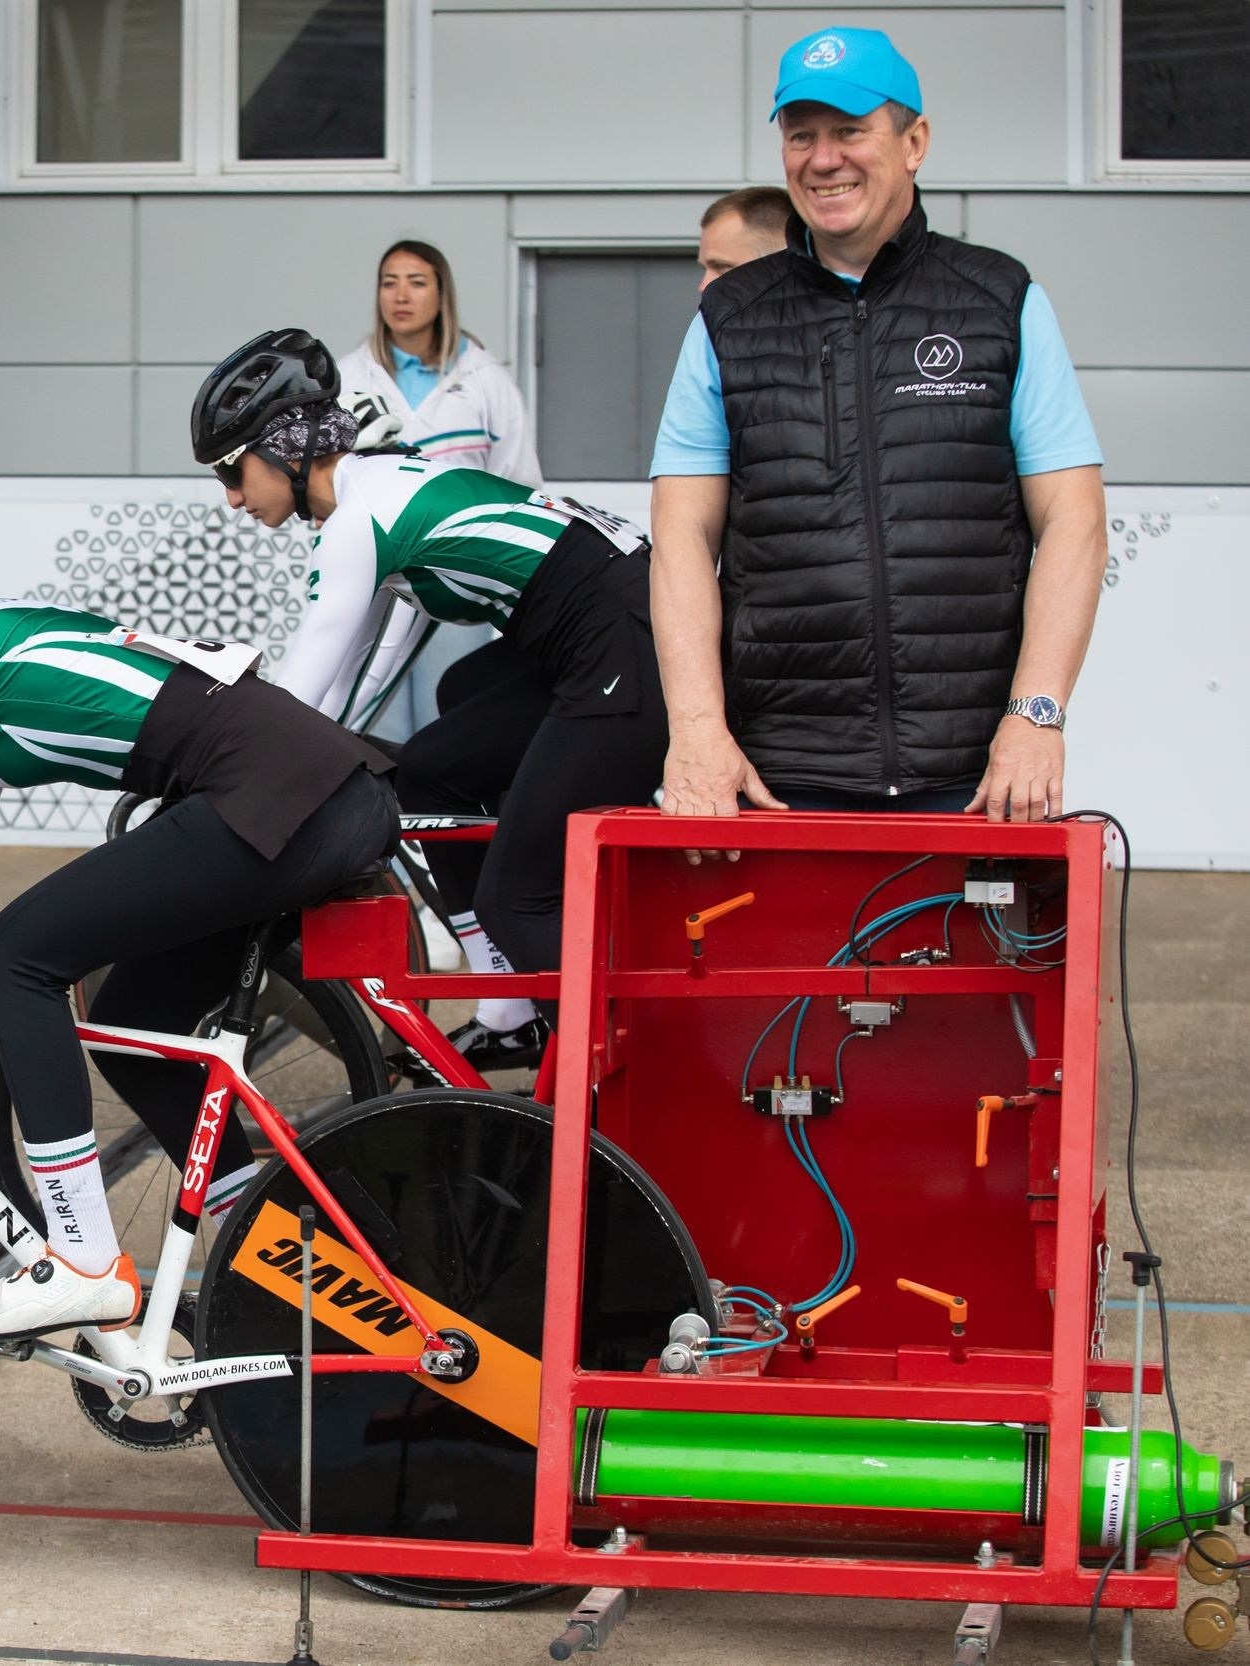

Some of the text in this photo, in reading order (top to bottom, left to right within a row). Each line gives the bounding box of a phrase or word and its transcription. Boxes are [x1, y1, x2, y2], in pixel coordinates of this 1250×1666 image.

[895, 382, 987, 394] MARATHON-TULA
[45, 1178, 84, 1243] I.R.IRAN
[256, 1238, 414, 1337] MAVIC
[159, 1360, 287, 1387] WWW.DOLAN-BIKES.COM
